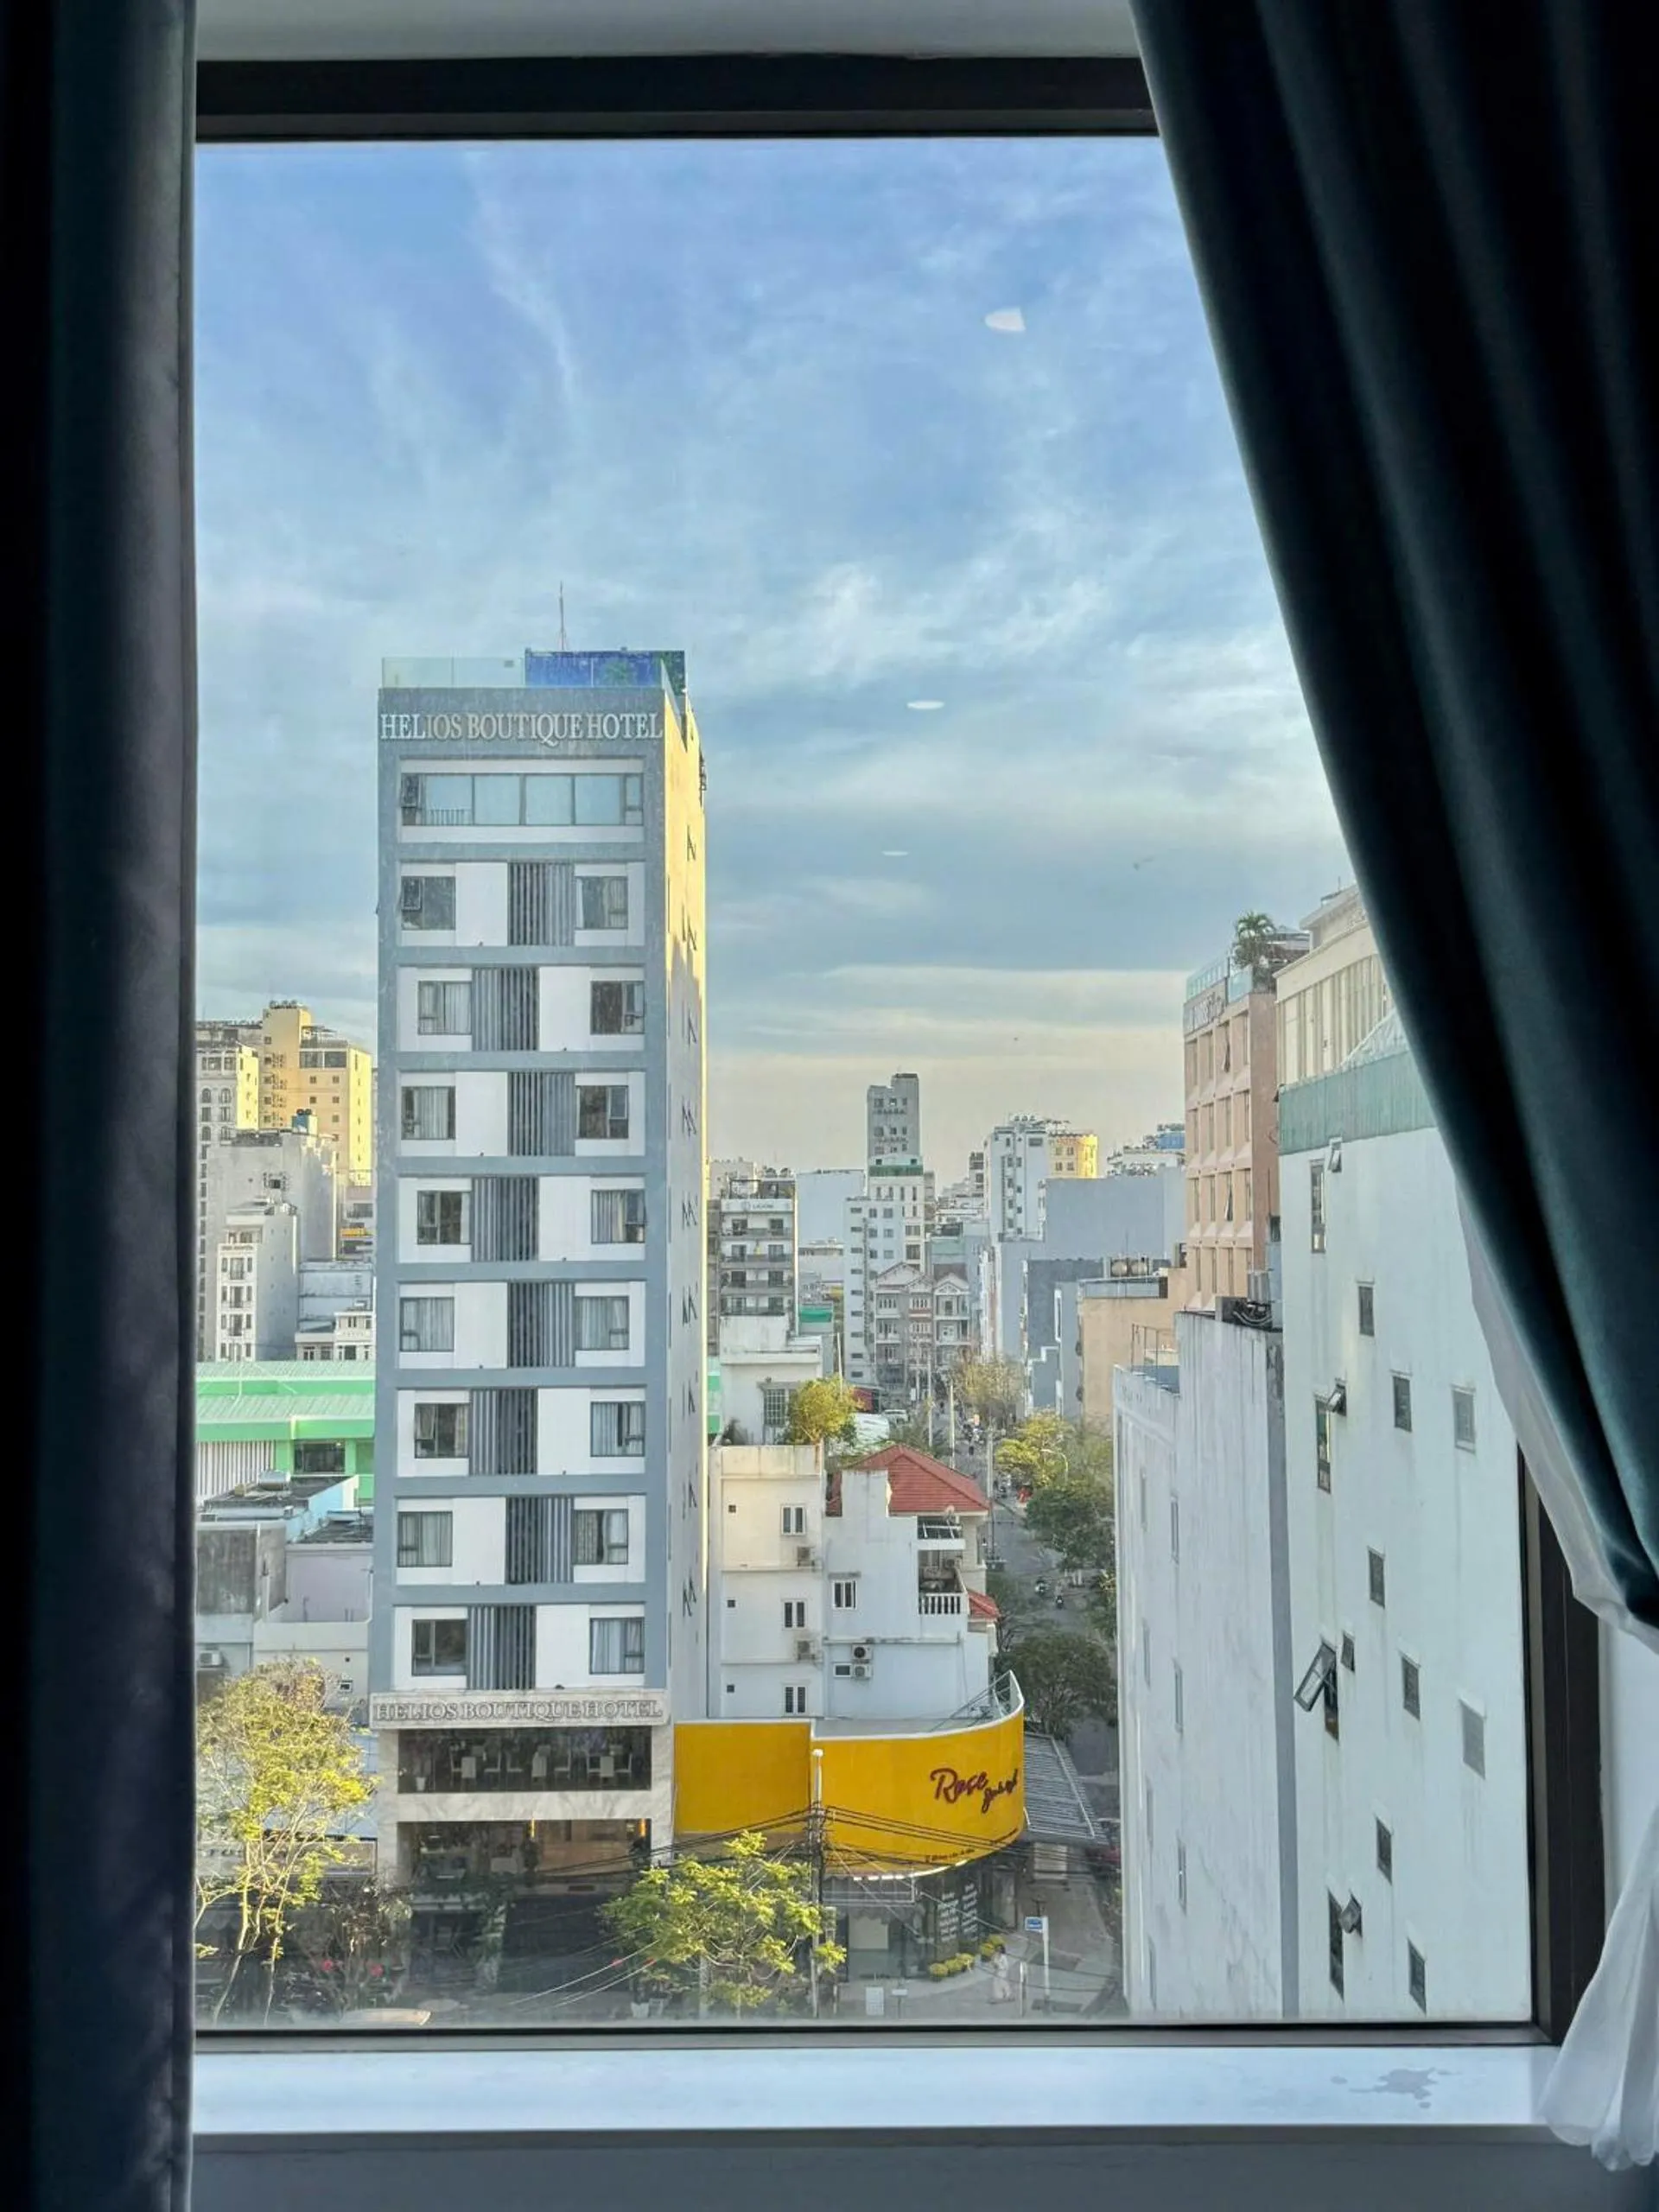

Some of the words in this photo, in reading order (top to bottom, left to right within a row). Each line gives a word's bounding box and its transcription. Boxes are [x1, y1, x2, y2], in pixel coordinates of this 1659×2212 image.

[380, 713, 462, 741] HELIOS
[467, 713, 583, 747] BOUTIQUE
[587, 712, 664, 740] HOTEL
[374, 1702, 458, 1721] HELIOS
[461, 1700, 581, 1722] BOUTIQUE
[582, 1700, 663, 1719] HOTEL
[930, 1767, 988, 1804] Rose
